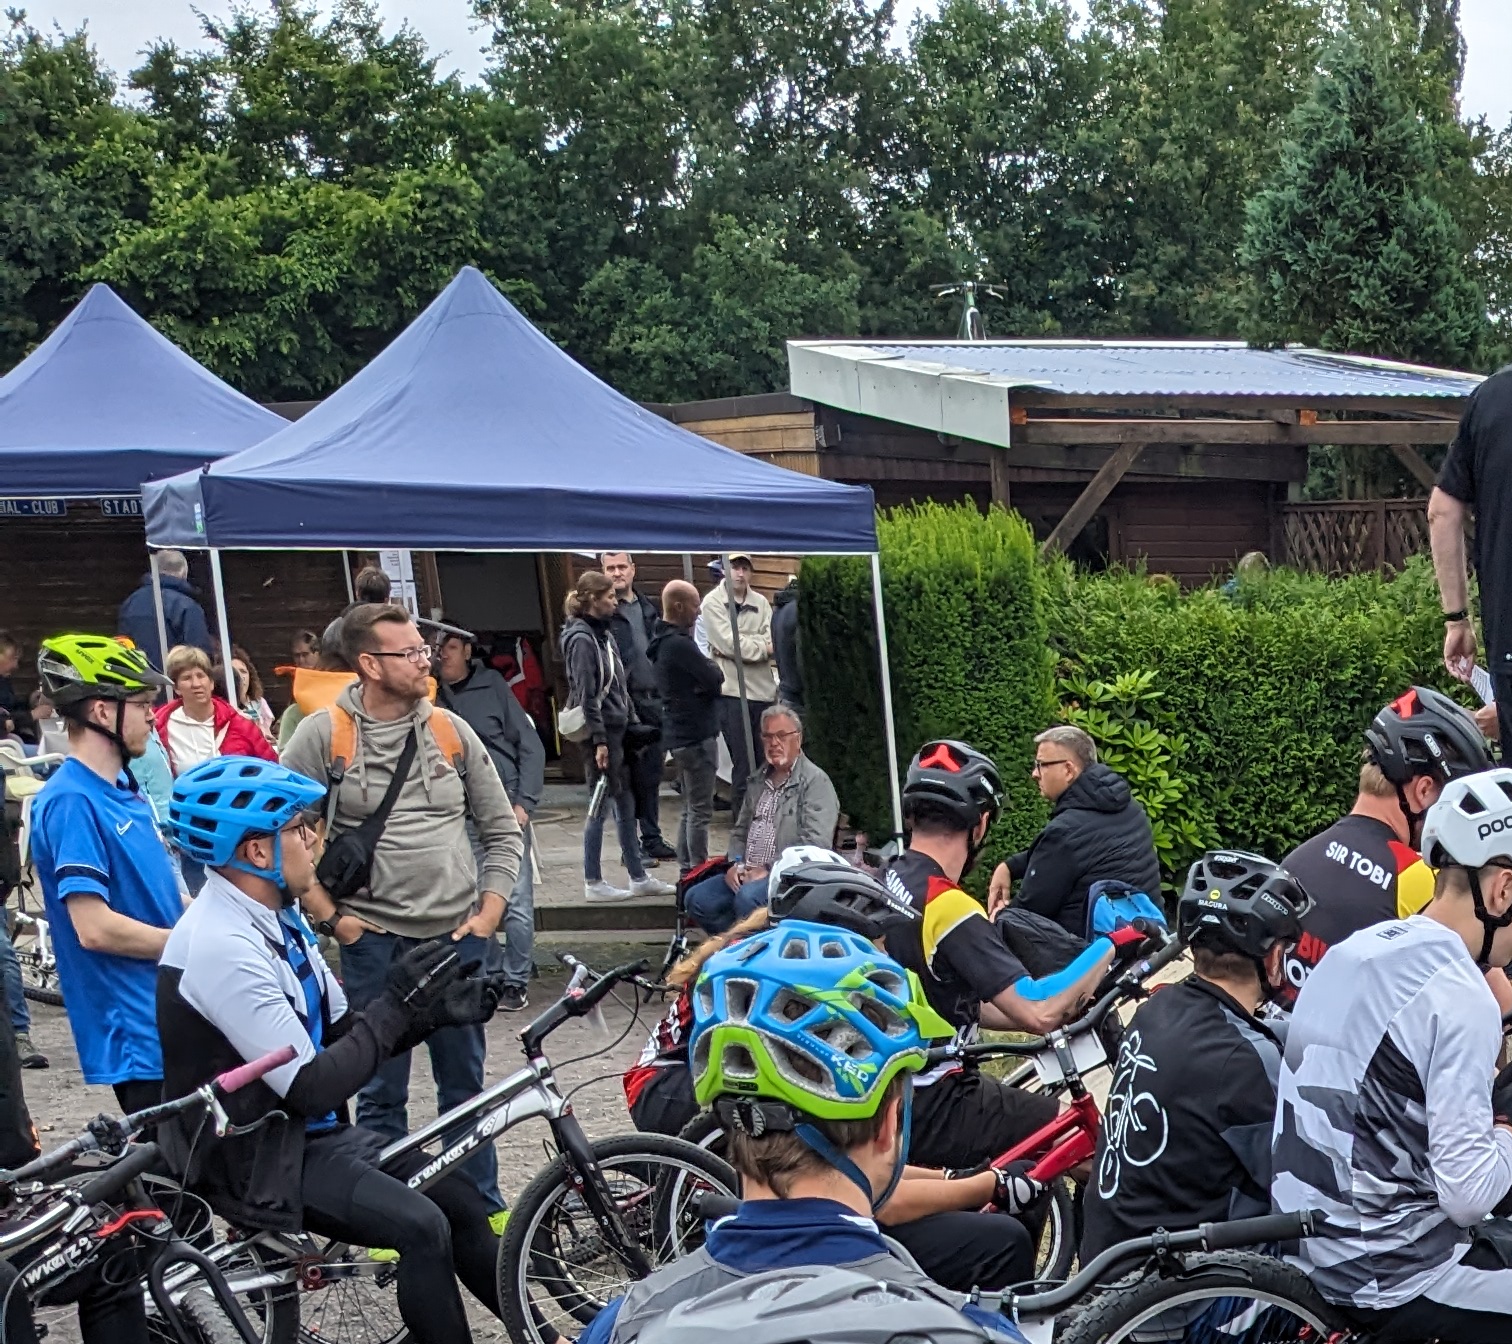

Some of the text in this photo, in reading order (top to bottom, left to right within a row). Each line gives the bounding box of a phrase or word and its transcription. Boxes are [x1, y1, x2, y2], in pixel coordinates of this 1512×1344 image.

[32, 500, 59, 514] CLUB
[103, 500, 142, 514] STAD
[1325, 841, 1393, 891] SIR TOBI
